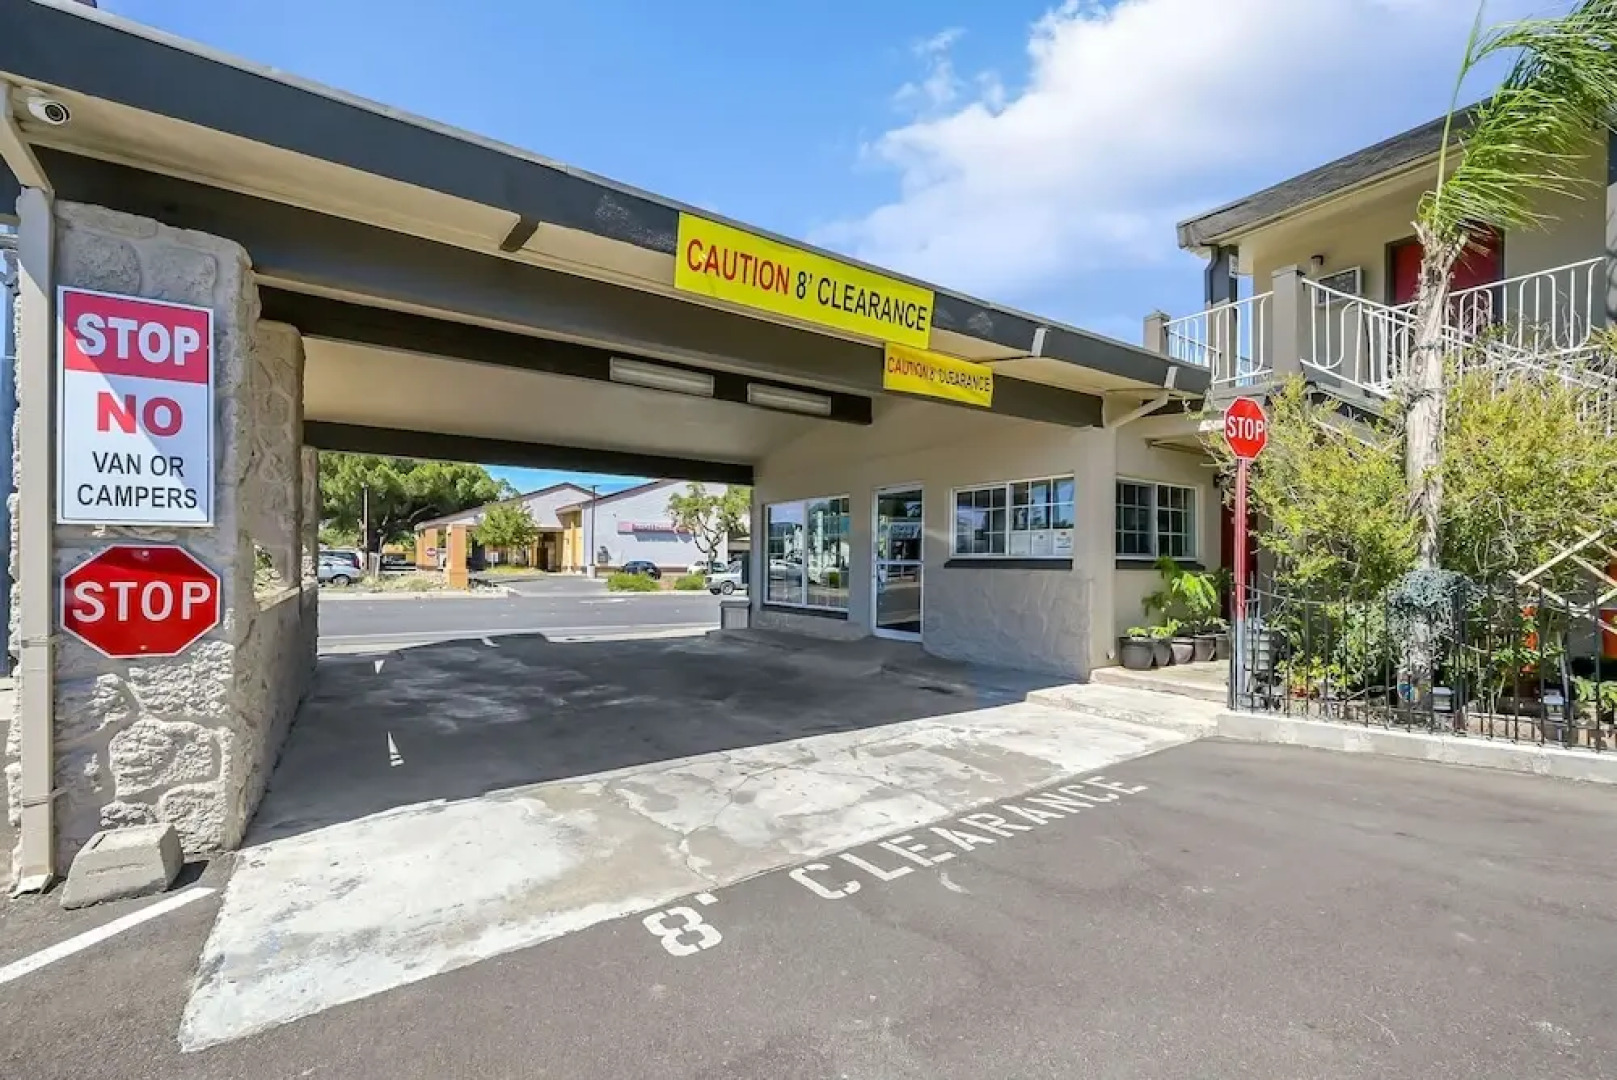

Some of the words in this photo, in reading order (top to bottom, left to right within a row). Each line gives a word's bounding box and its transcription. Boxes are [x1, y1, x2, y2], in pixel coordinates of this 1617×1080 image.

[687, 239, 790, 295] CAUTION
[796, 271, 813, 300] 8'
[817, 276, 928, 331] CLEARANCE
[75, 313, 200, 366] STOP
[888, 356, 929, 380] CAUTION
[938, 368, 991, 392] CLEARANCE
[96, 392, 183, 437] NO
[1226, 415, 1264, 441] STOP
[92, 451, 141, 476] VAN
[150, 454, 185, 478] OR
[77, 484, 198, 509] CAMPERS
[72, 580, 211, 622] STOP
[642, 892, 722, 957] 8'
[788, 775, 1148, 900] CLEARANCE
